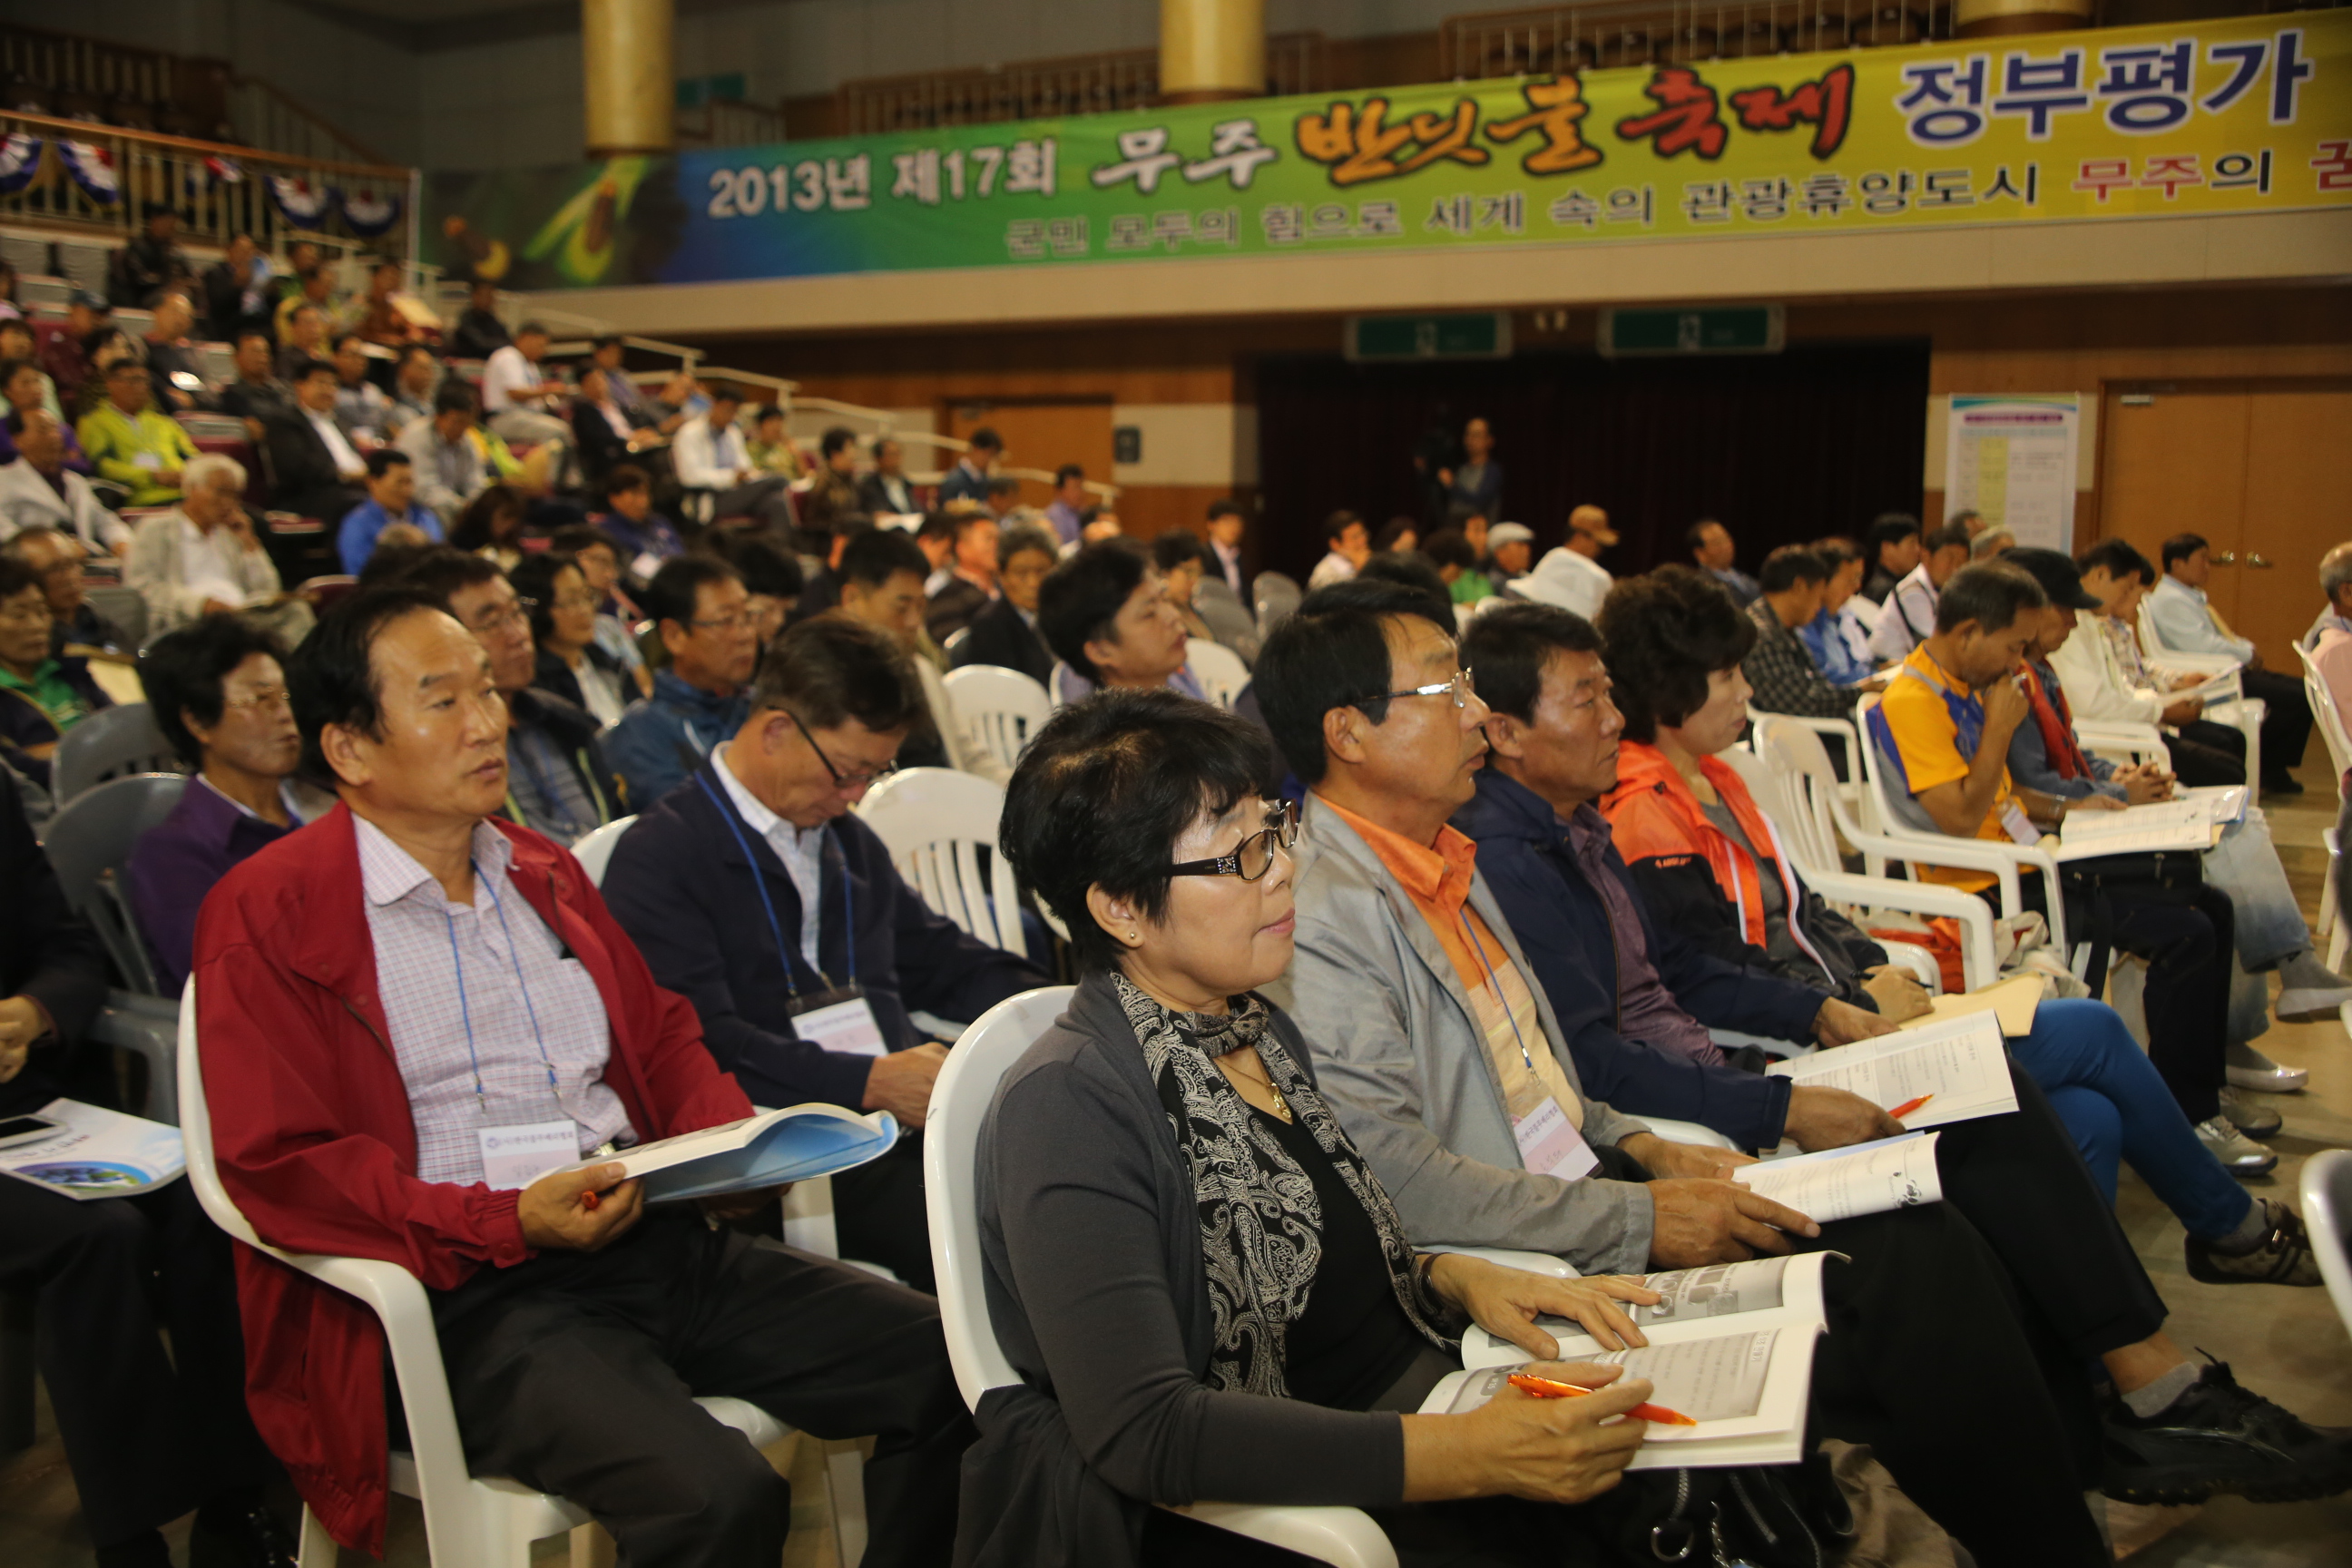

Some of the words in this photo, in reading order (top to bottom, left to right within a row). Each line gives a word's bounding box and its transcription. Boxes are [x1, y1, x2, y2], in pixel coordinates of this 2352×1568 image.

[708, 152, 871, 219] 2013년
[891, 137, 1057, 205] 제17회
[1092, 118, 1276, 193] 무주
[1294, 73, 1605, 188] 반딧불
[1615, 61, 1856, 162] 축제
[1896, 28, 2311, 146] 정부평가
[1426, 191, 1524, 235] 세계
[1548, 185, 1653, 231] 속의
[1681, 161, 2040, 224] 관광휴양도시
[2071, 147, 2274, 203] 무주의
